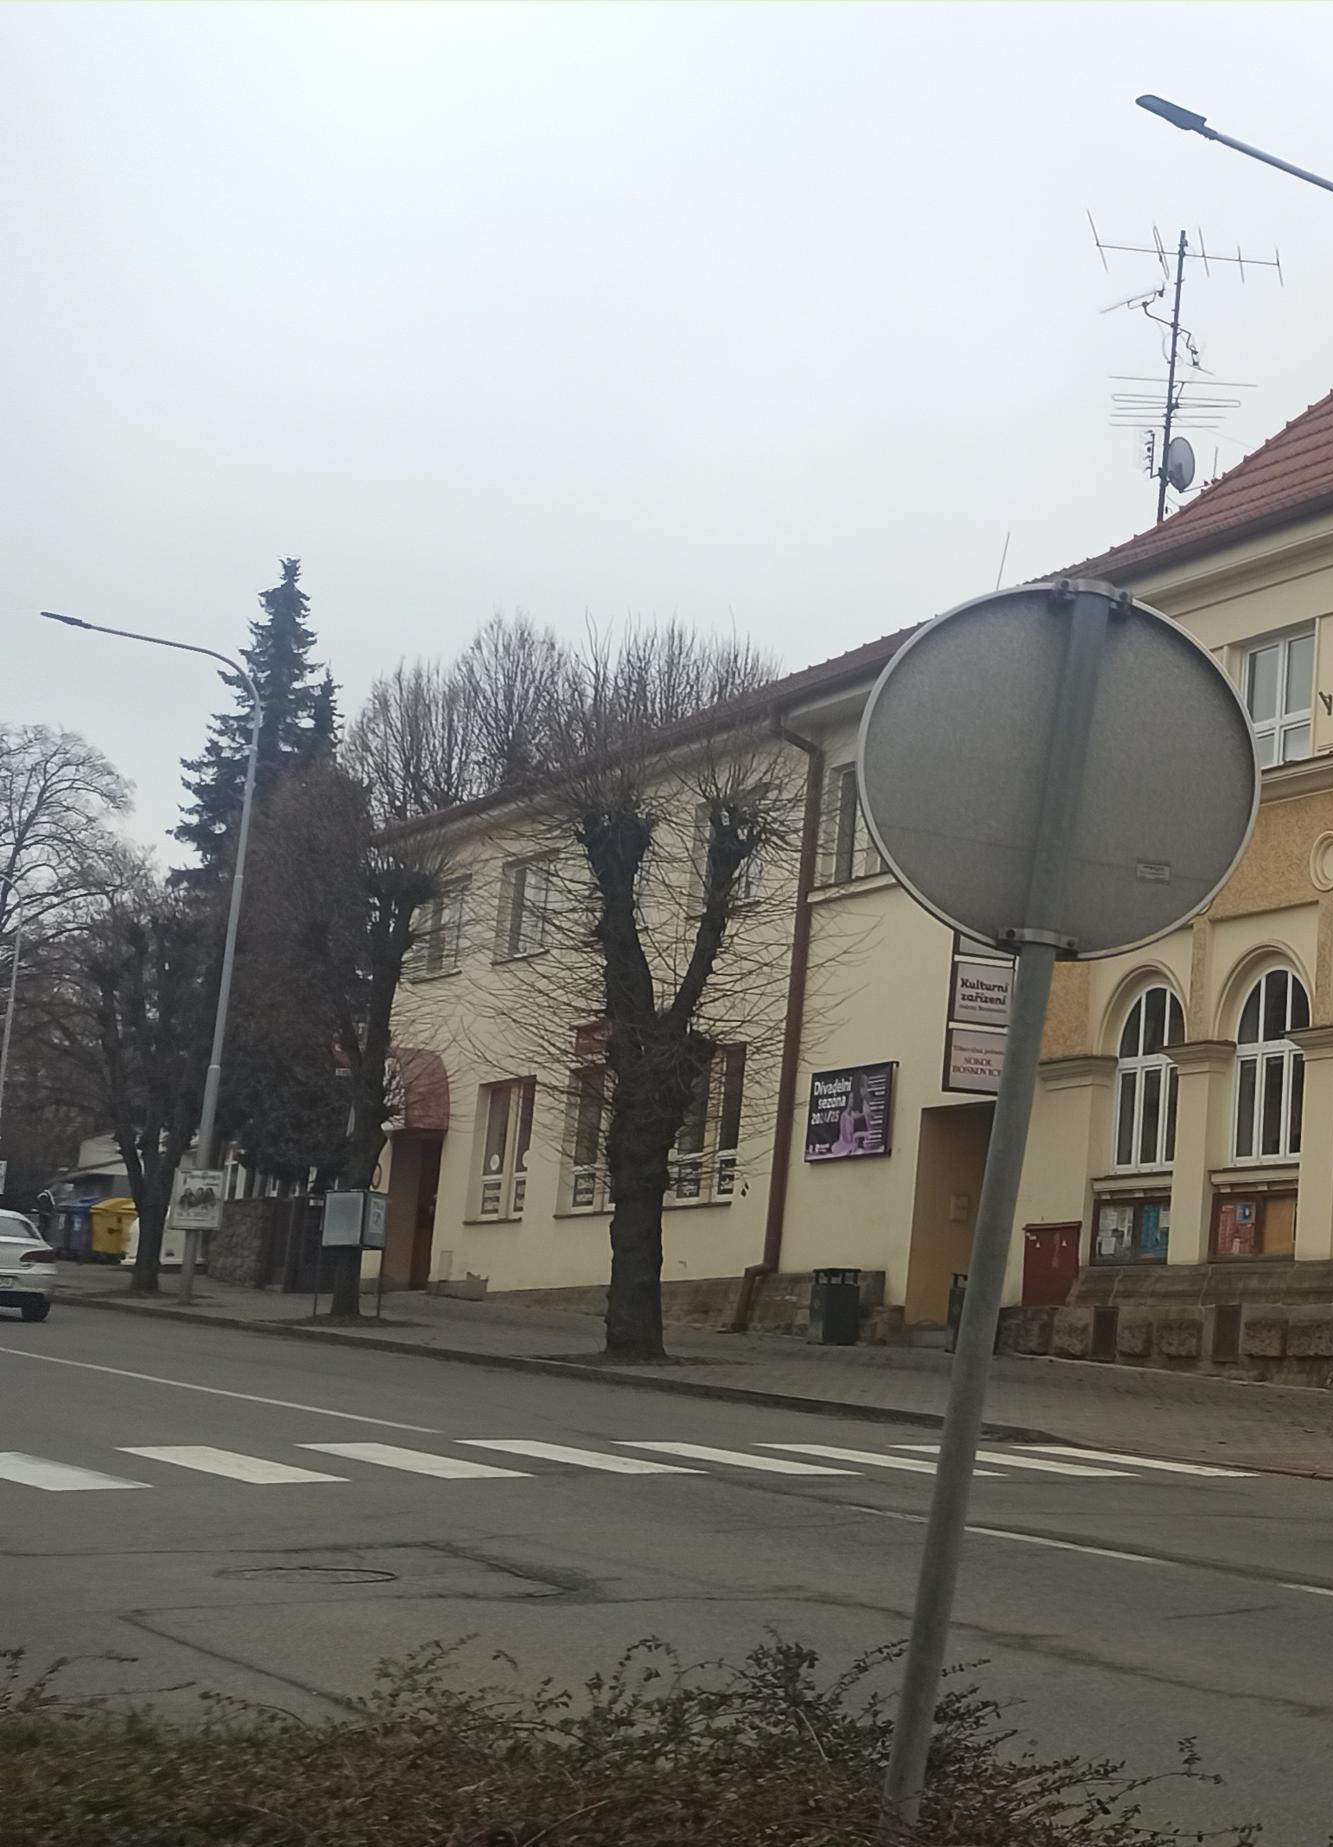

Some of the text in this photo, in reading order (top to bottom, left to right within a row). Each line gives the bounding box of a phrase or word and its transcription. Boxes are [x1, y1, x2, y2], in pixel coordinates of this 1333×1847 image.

[960, 977, 1009, 993] Kulturní
[960, 992, 1006, 1006] zařízení
[963, 1057, 992, 1066] SOKOL
[814, 1077, 853, 1096] Divadelní
[818, 1095, 846, 1110] sezóna
